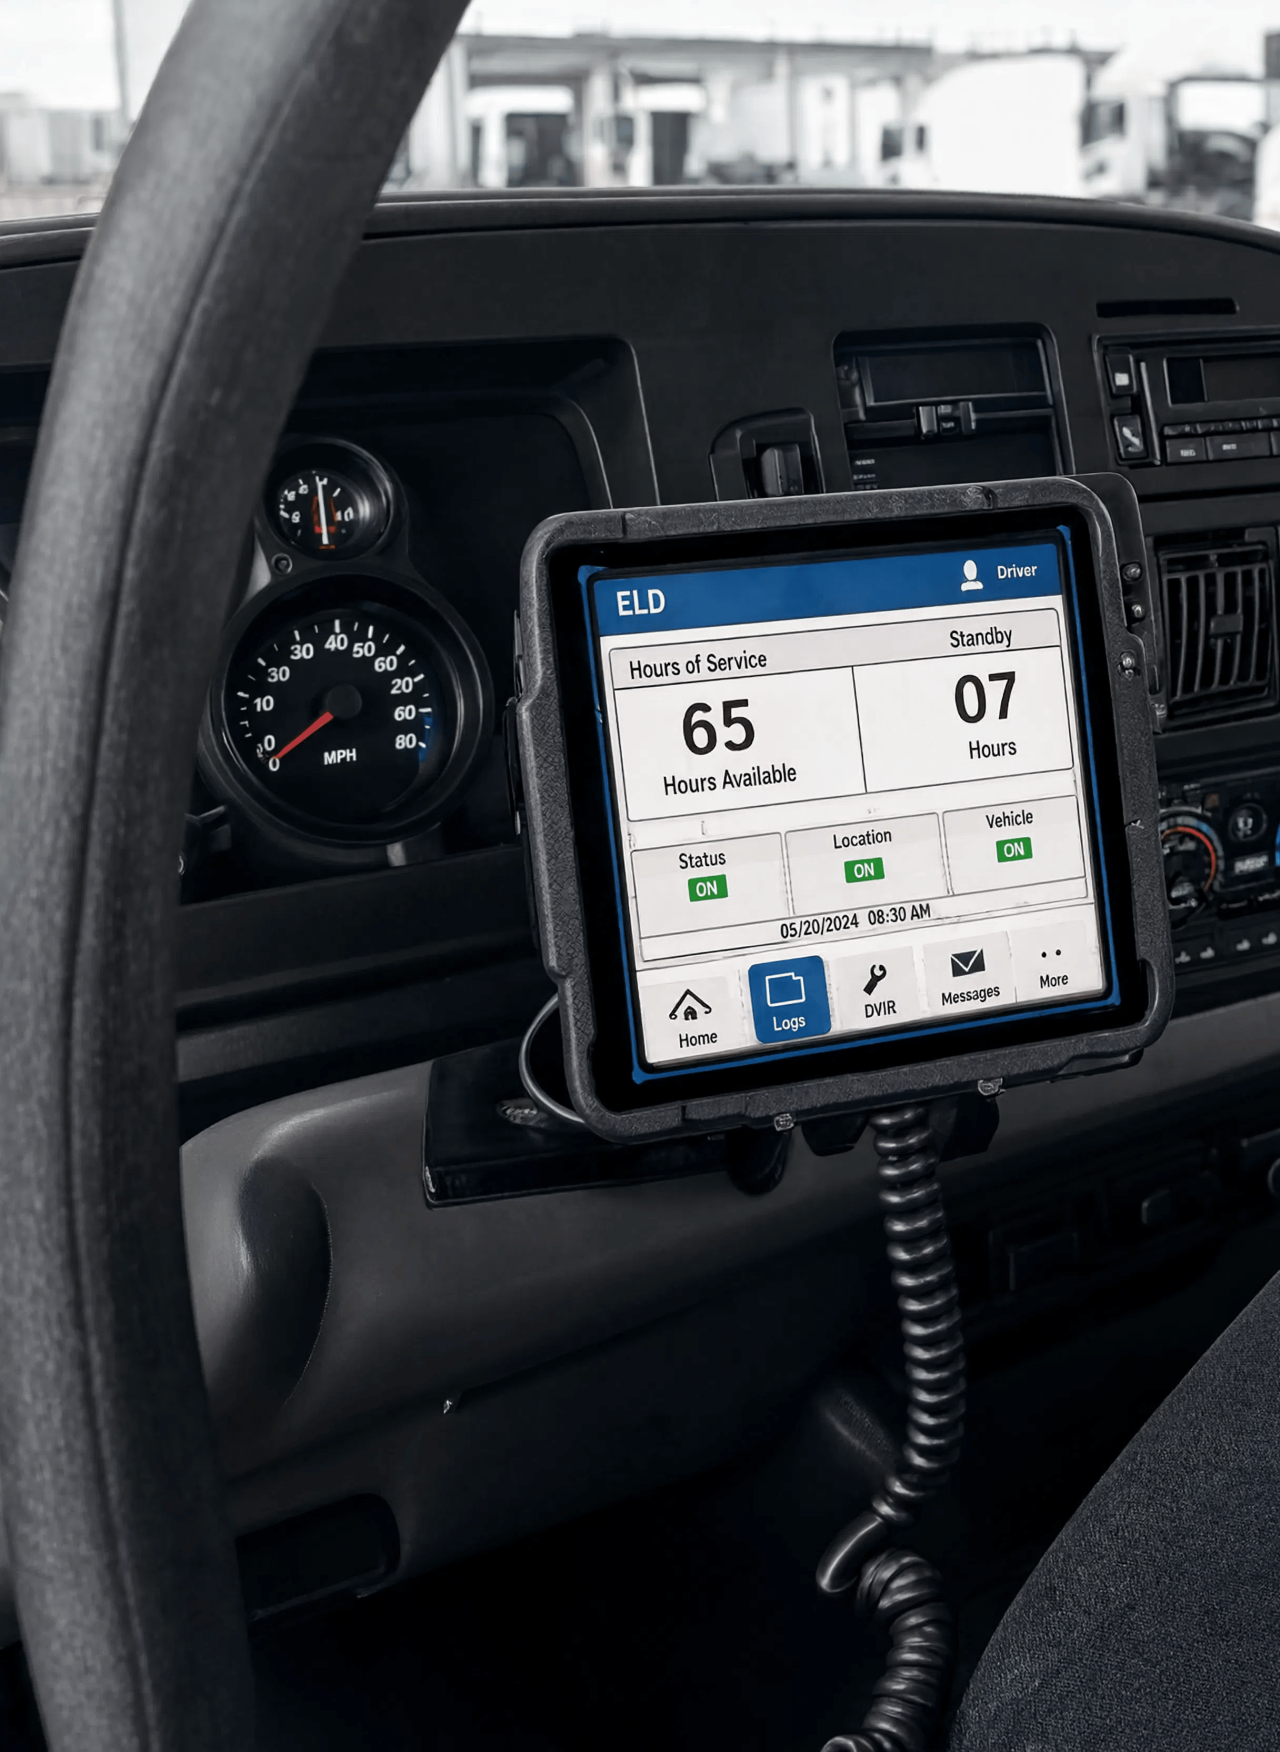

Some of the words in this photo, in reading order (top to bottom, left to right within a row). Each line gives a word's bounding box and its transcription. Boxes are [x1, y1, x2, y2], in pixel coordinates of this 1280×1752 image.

[998, 564, 1037, 578] Driver
[617, 589, 665, 616] ELD
[325, 634, 348, 651] 40
[950, 627, 1011, 648] Standby
[291, 643, 313, 659] 30
[353, 641, 375, 657] 50
[375, 656, 397, 672] 60
[630, 660, 680, 679] Hours
[686, 654, 701, 674] of
[707, 650, 766, 672] Service
[268, 666, 290, 682] 30
[391, 677, 413, 694] 20
[254, 696, 274, 711] 10
[955, 671, 1015, 723] 07
[394, 705, 416, 721] 60
[683, 699, 754, 755] 65
[395, 733, 416, 749] 80
[324, 748, 356, 765] MPH
[969, 740, 1016, 759] Hours
[664, 776, 716, 795] Hours
[723, 763, 796, 789] Available
[986, 810, 1033, 828] Vehicle
[834, 831, 891, 849] Location
[1004, 842, 1024, 857] ON
[679, 853, 726, 869] Status
[854, 863, 874, 878] ON
[696, 881, 717, 896] ON
[780, 912, 860, 939] 05/20/2024
[868, 906, 906, 925] 08:30
[911, 903, 930, 920] AM
[1040, 975, 1068, 988] More
[941, 986, 1000, 1006] Messages
[865, 1000, 896, 1018] DVIR
[773, 1017, 805, 1031] Logs
[679, 1033, 717, 1048] Home
